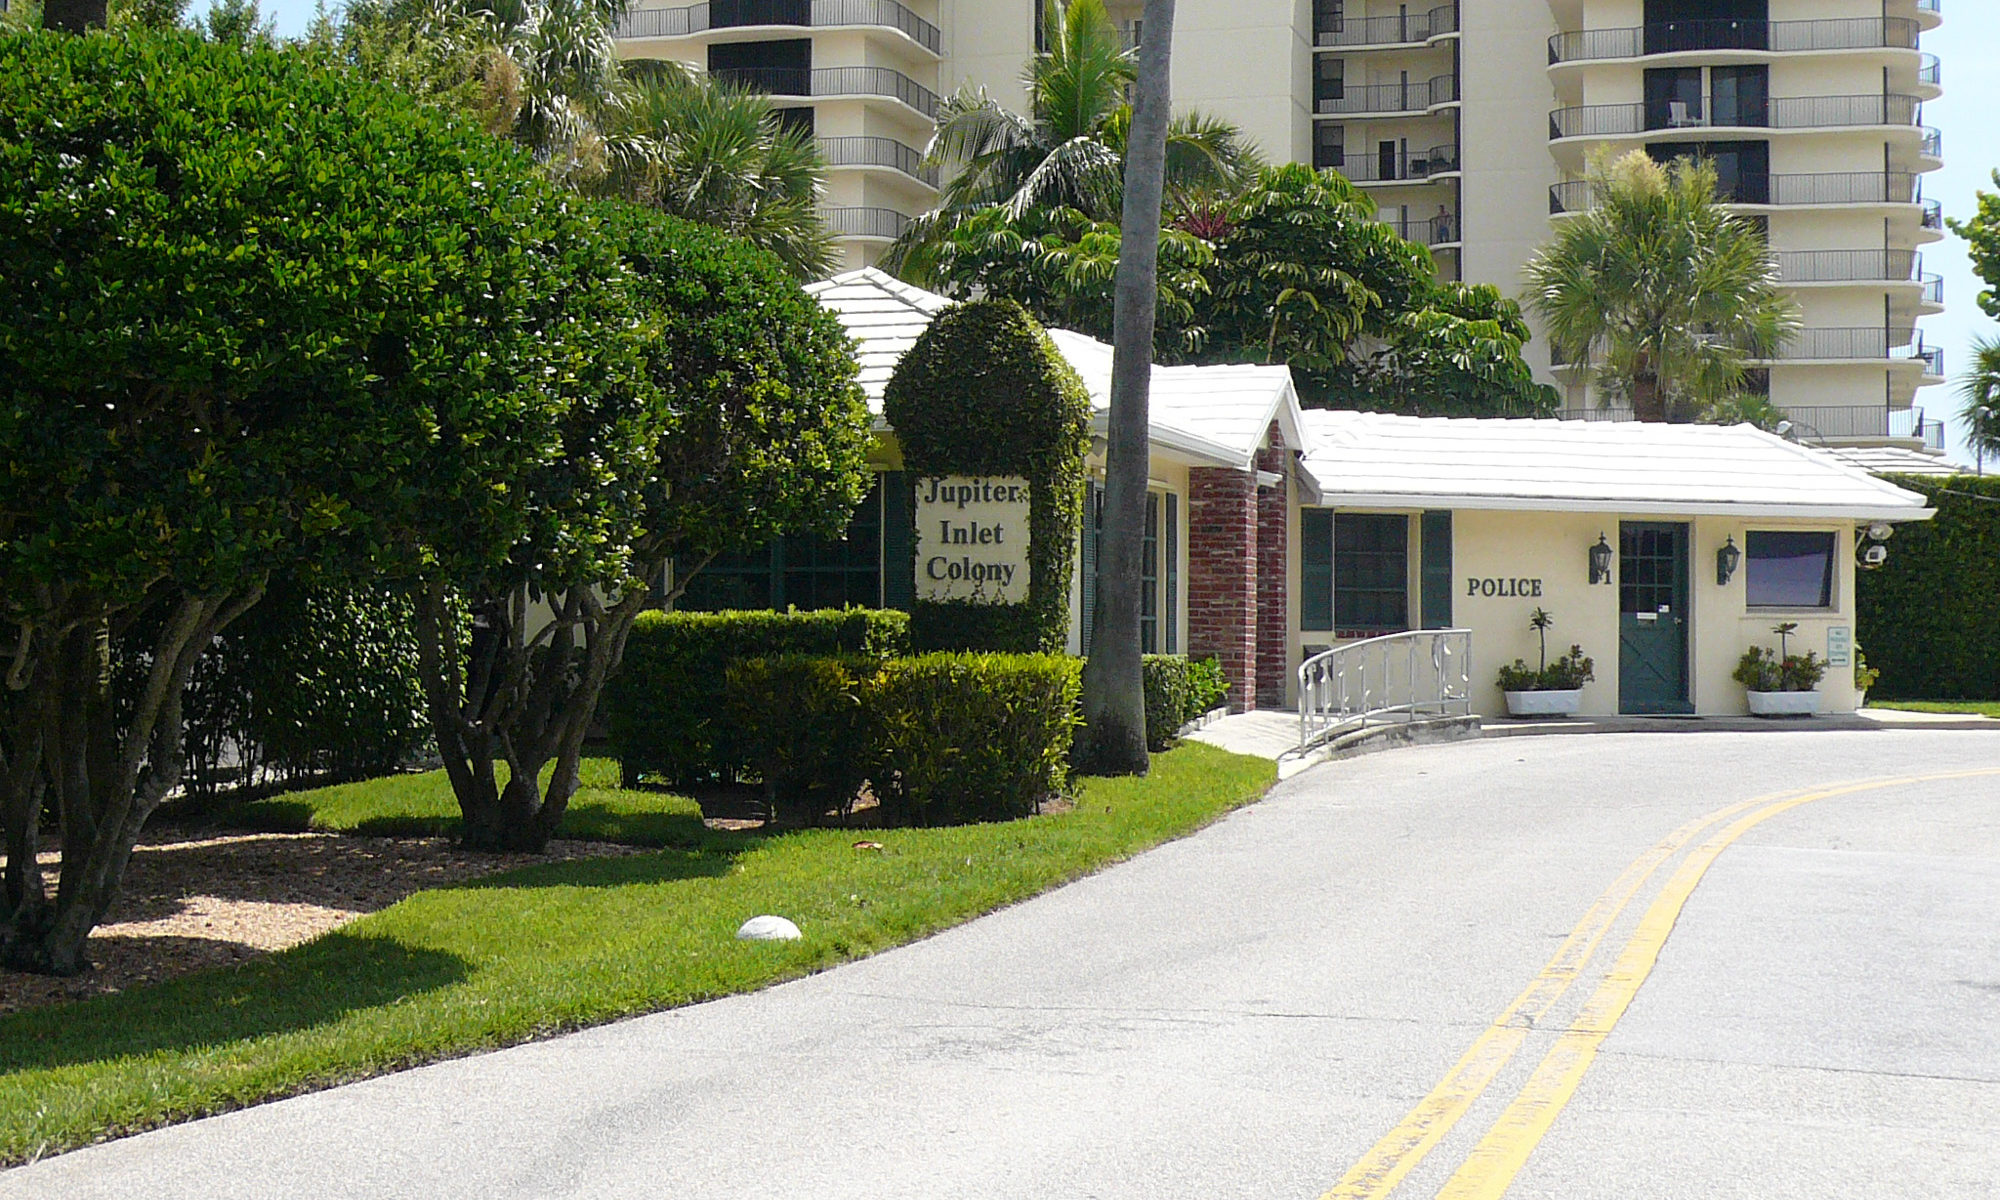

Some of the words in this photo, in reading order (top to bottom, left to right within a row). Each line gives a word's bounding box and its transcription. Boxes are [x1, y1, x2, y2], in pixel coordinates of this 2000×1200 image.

[924, 479, 1019, 509] Jupiter
[940, 520, 1004, 544] Inlet
[927, 556, 1015, 587] Colony
[1467, 578, 1542, 597] POLICE
